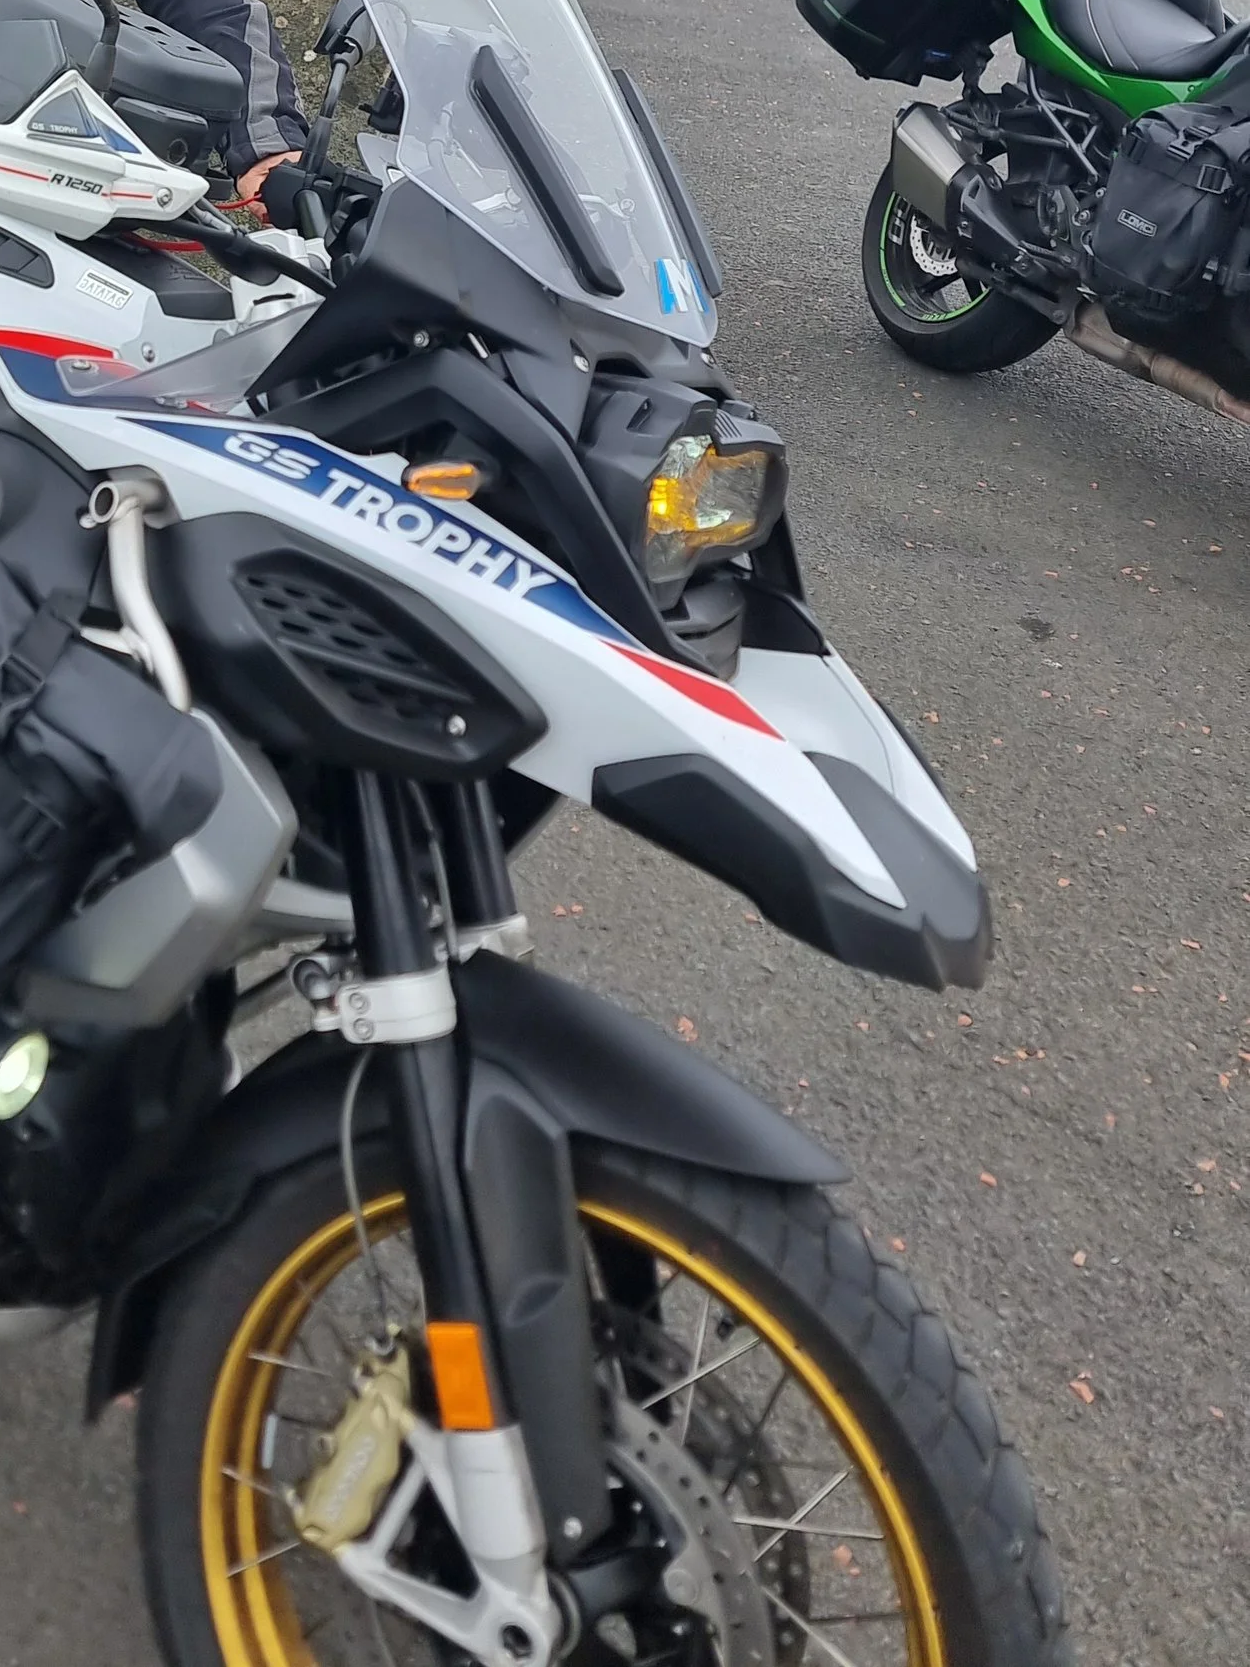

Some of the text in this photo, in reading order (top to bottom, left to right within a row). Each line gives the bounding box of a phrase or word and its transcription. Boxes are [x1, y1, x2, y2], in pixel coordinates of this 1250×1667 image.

[1120, 212, 1155, 234] LOMO
[223, 432, 557, 599] GS TROPHY
